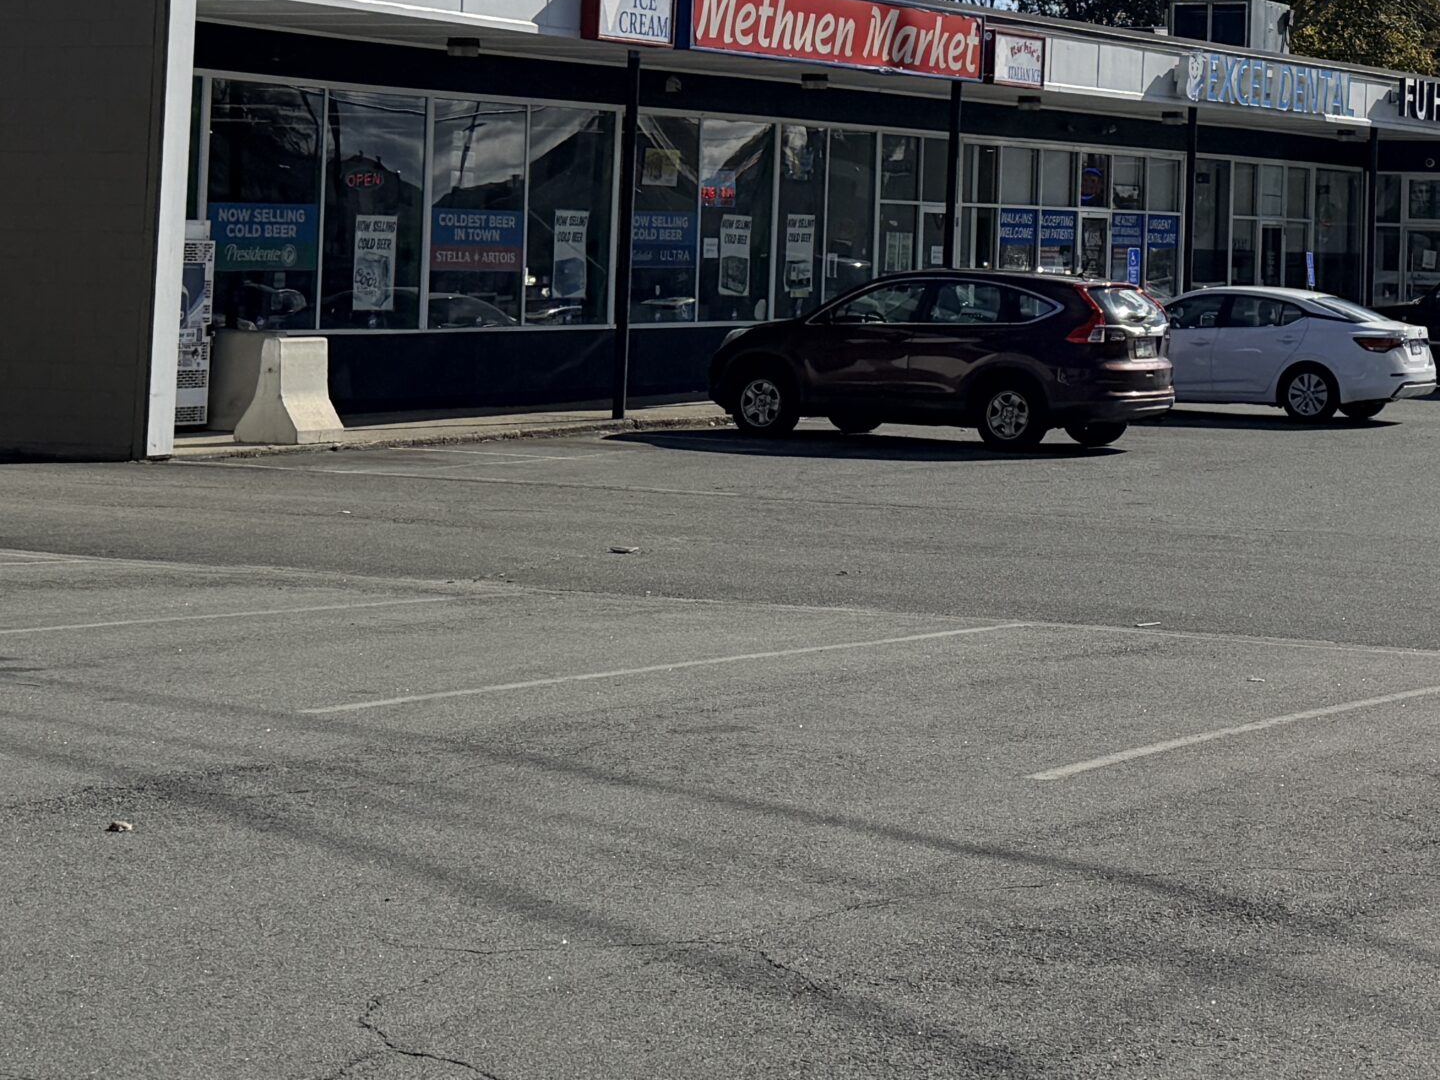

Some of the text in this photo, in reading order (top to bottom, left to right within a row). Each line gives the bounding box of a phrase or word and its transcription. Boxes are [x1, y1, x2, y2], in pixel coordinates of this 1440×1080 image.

[619, 10, 669, 38] CREAM
[863, 6, 980, 73] Market
[1008, 66, 1030, 81] ITALIAN
[1207, 55, 1354, 117] EXCEL DENTAL
[1403, 78, 1427, 120] FU
[346, 173, 382, 187] OPEN
[218, 208, 306, 223] NOW SELLING
[438, 214, 515, 229] COLDEST BEER
[633, 216, 689, 228] OW SELLING
[226, 224, 297, 238] COLD BEER
[454, 228, 501, 241] IN TOWN
[633, 228, 682, 241] COLD BEER
[1000, 226, 1033, 239] WELCOME
[1147, 232, 1162, 244] ENTAL
[357, 237, 392, 250] COLD BEER
[224, 243, 282, 262] Presidente
[435, 251, 516, 263] STELLA ARTOIS
[659, 249, 690, 261] ULTRA
